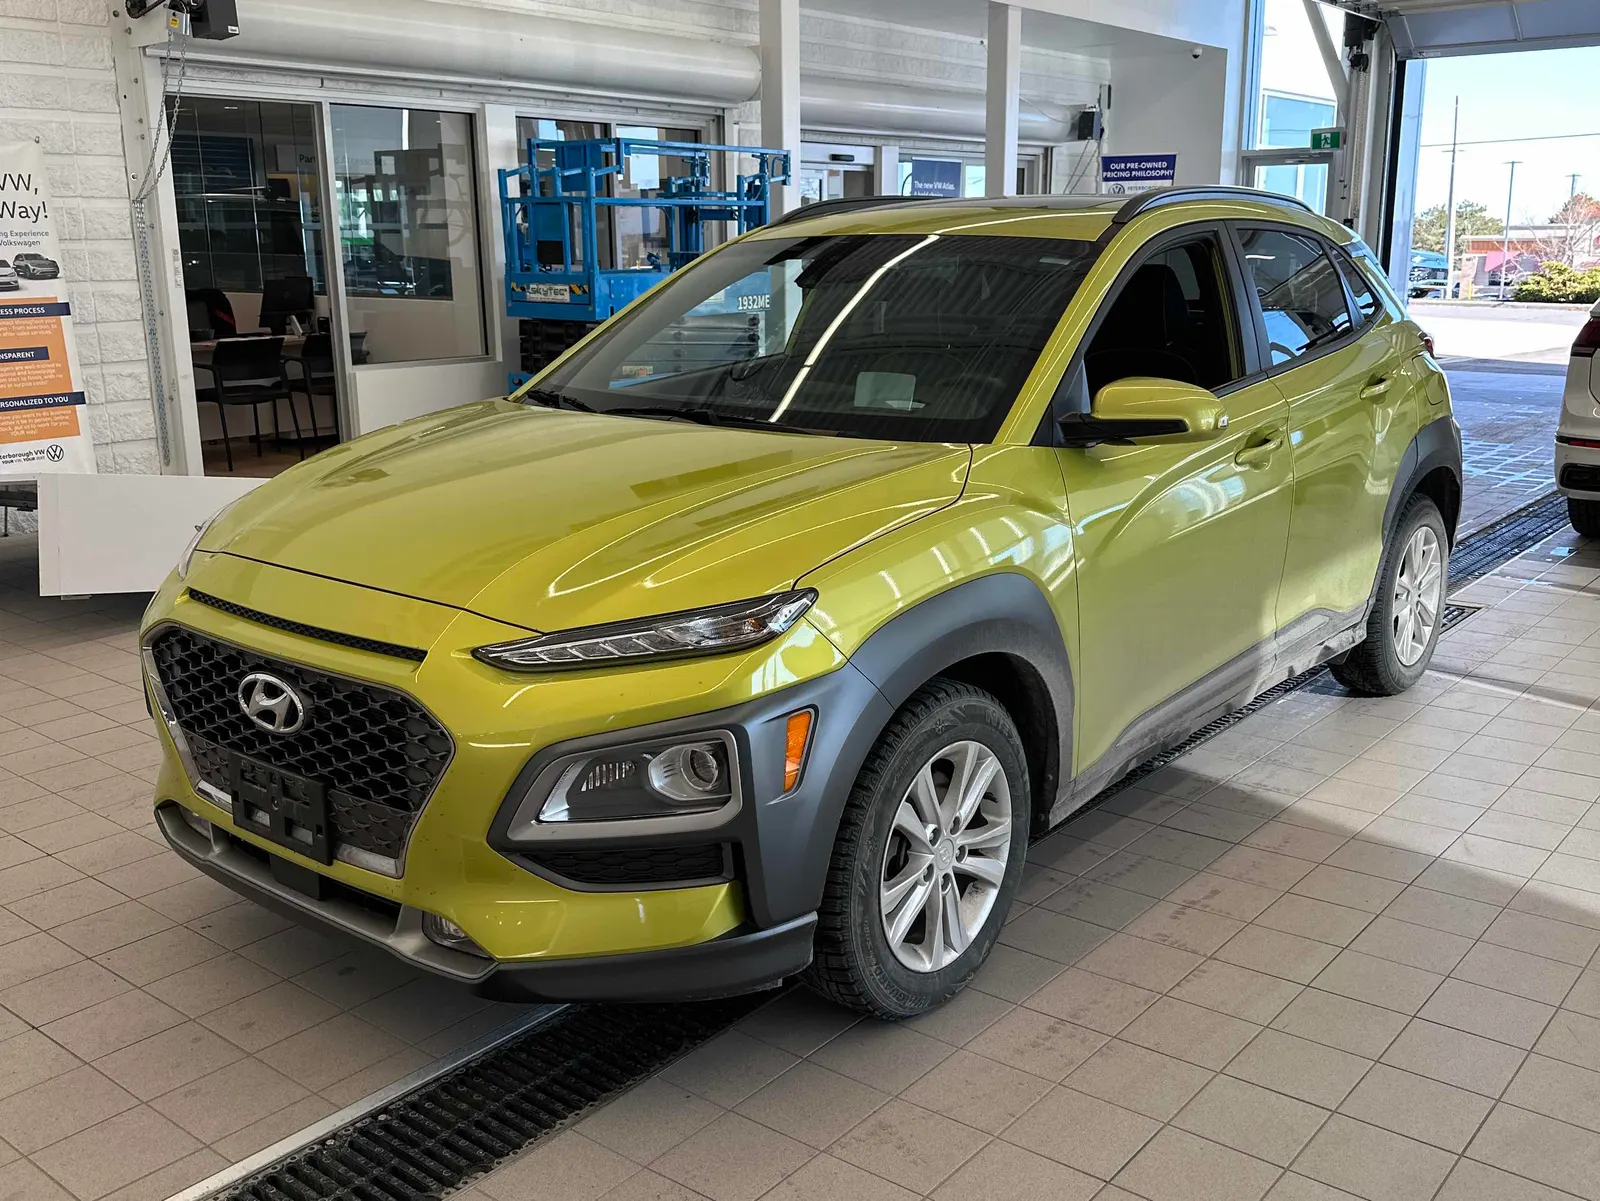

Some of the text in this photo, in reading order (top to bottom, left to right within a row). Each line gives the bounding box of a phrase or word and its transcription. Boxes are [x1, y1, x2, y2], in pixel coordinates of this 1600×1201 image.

[1126, 161, 1168, 169] PRE-OWNED
[1131, 169, 1174, 177] PHILOSOPHY
[914, 180, 923, 189] The
[934, 181, 943, 189] VW
[10, 230, 49, 238] Experience
[738, 294, 770, 310] 1932ME
[14, 306, 45, 315] PROCESS
